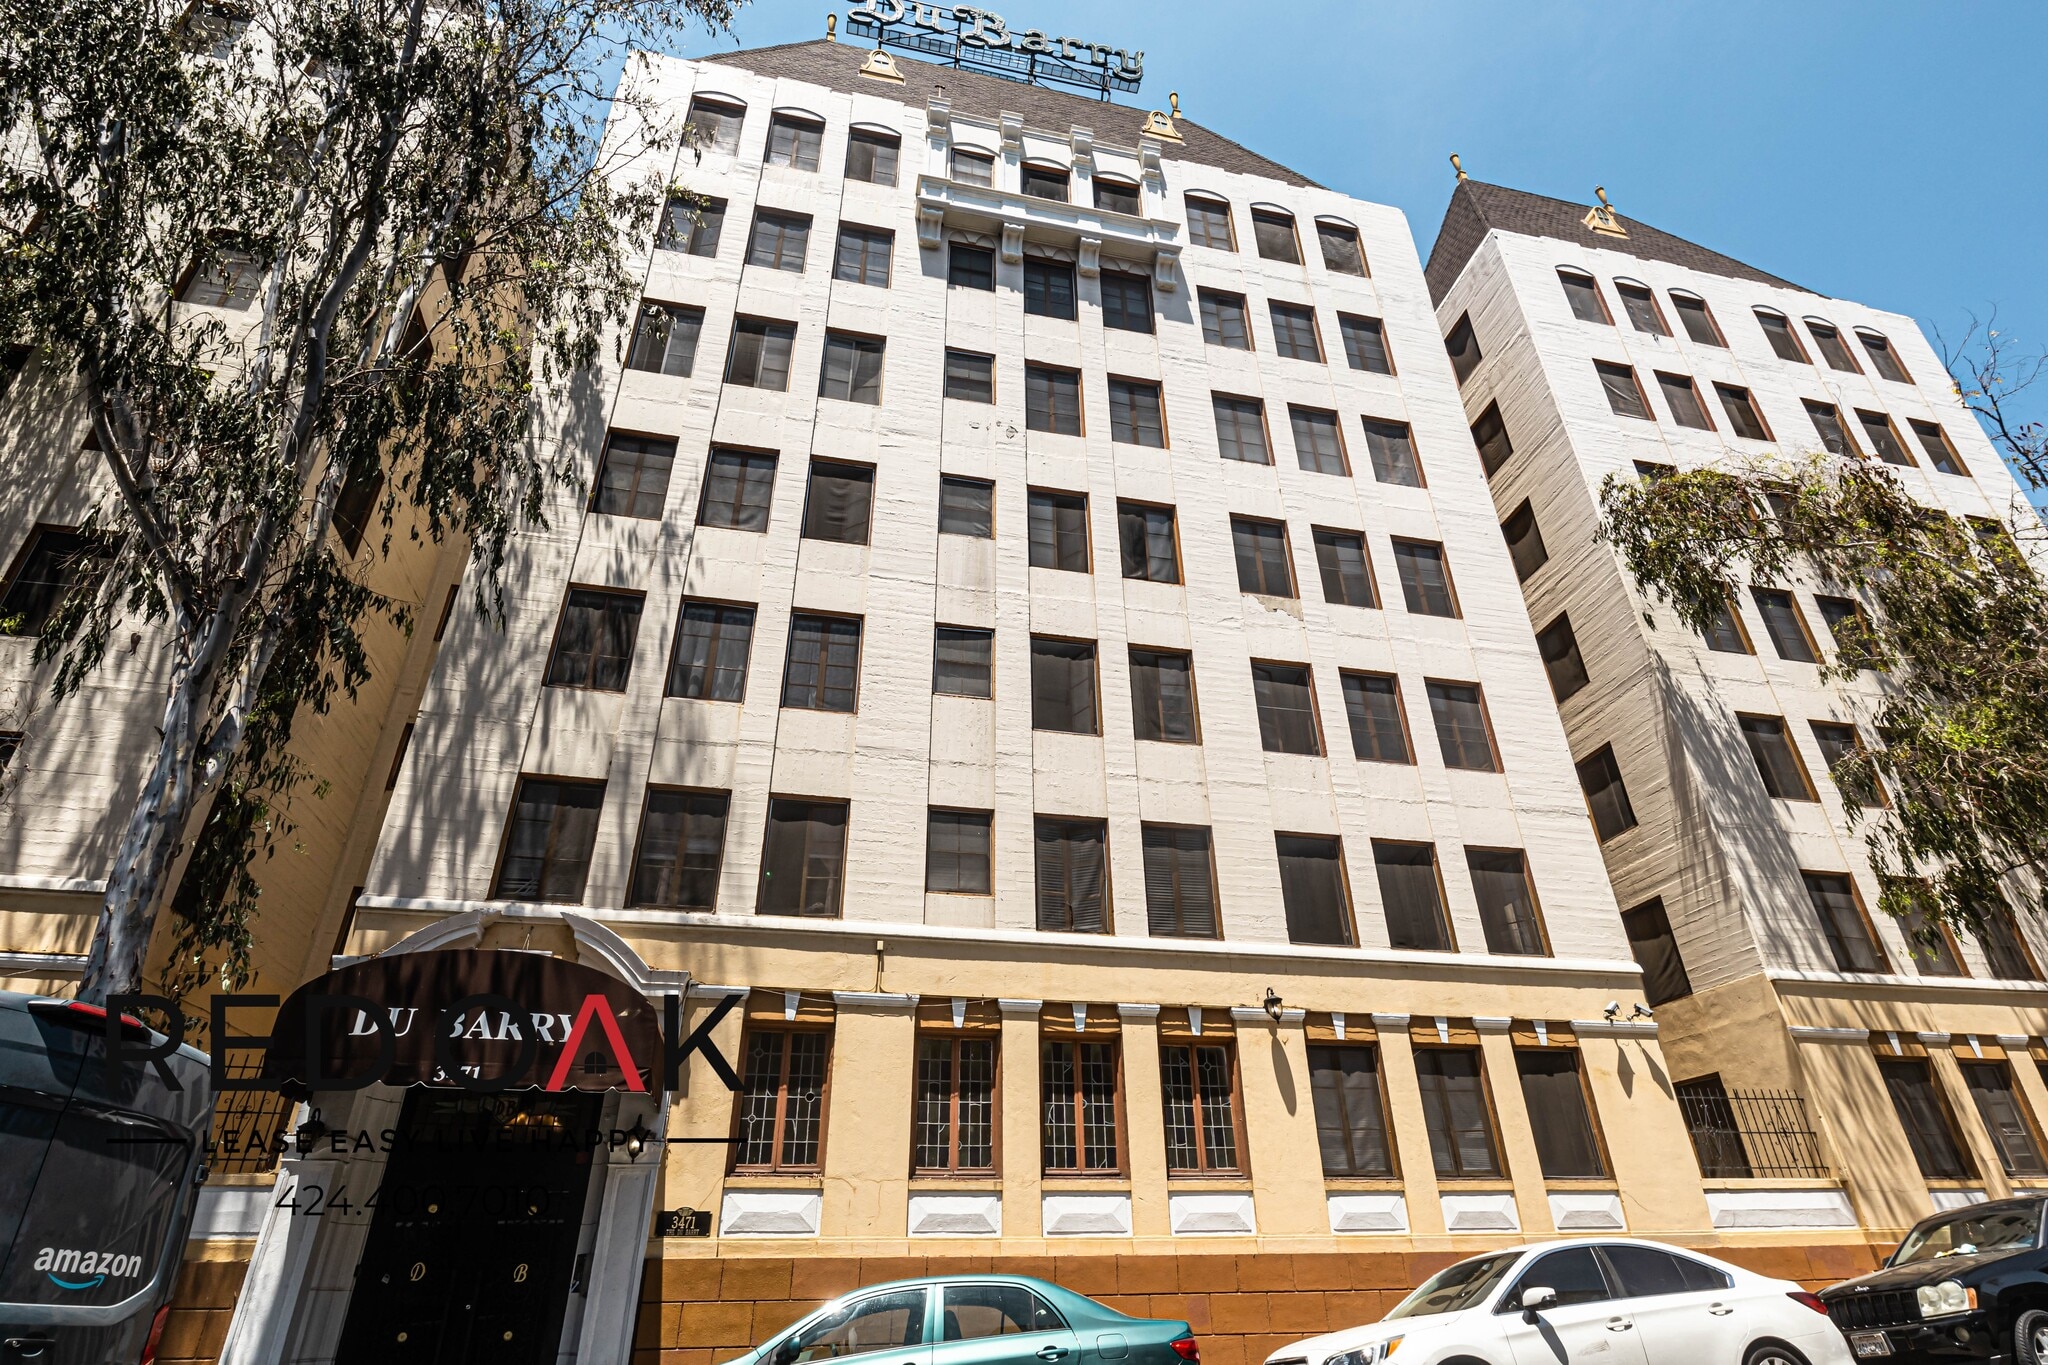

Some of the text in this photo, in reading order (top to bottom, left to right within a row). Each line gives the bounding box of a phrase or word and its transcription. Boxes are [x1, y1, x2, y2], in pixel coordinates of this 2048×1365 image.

[433, 1066, 481, 1082] 371
[671, 1215, 696, 1229] 3471
[34, 1247, 142, 1278] amazon
[410, 1262, 529, 1283] D B
